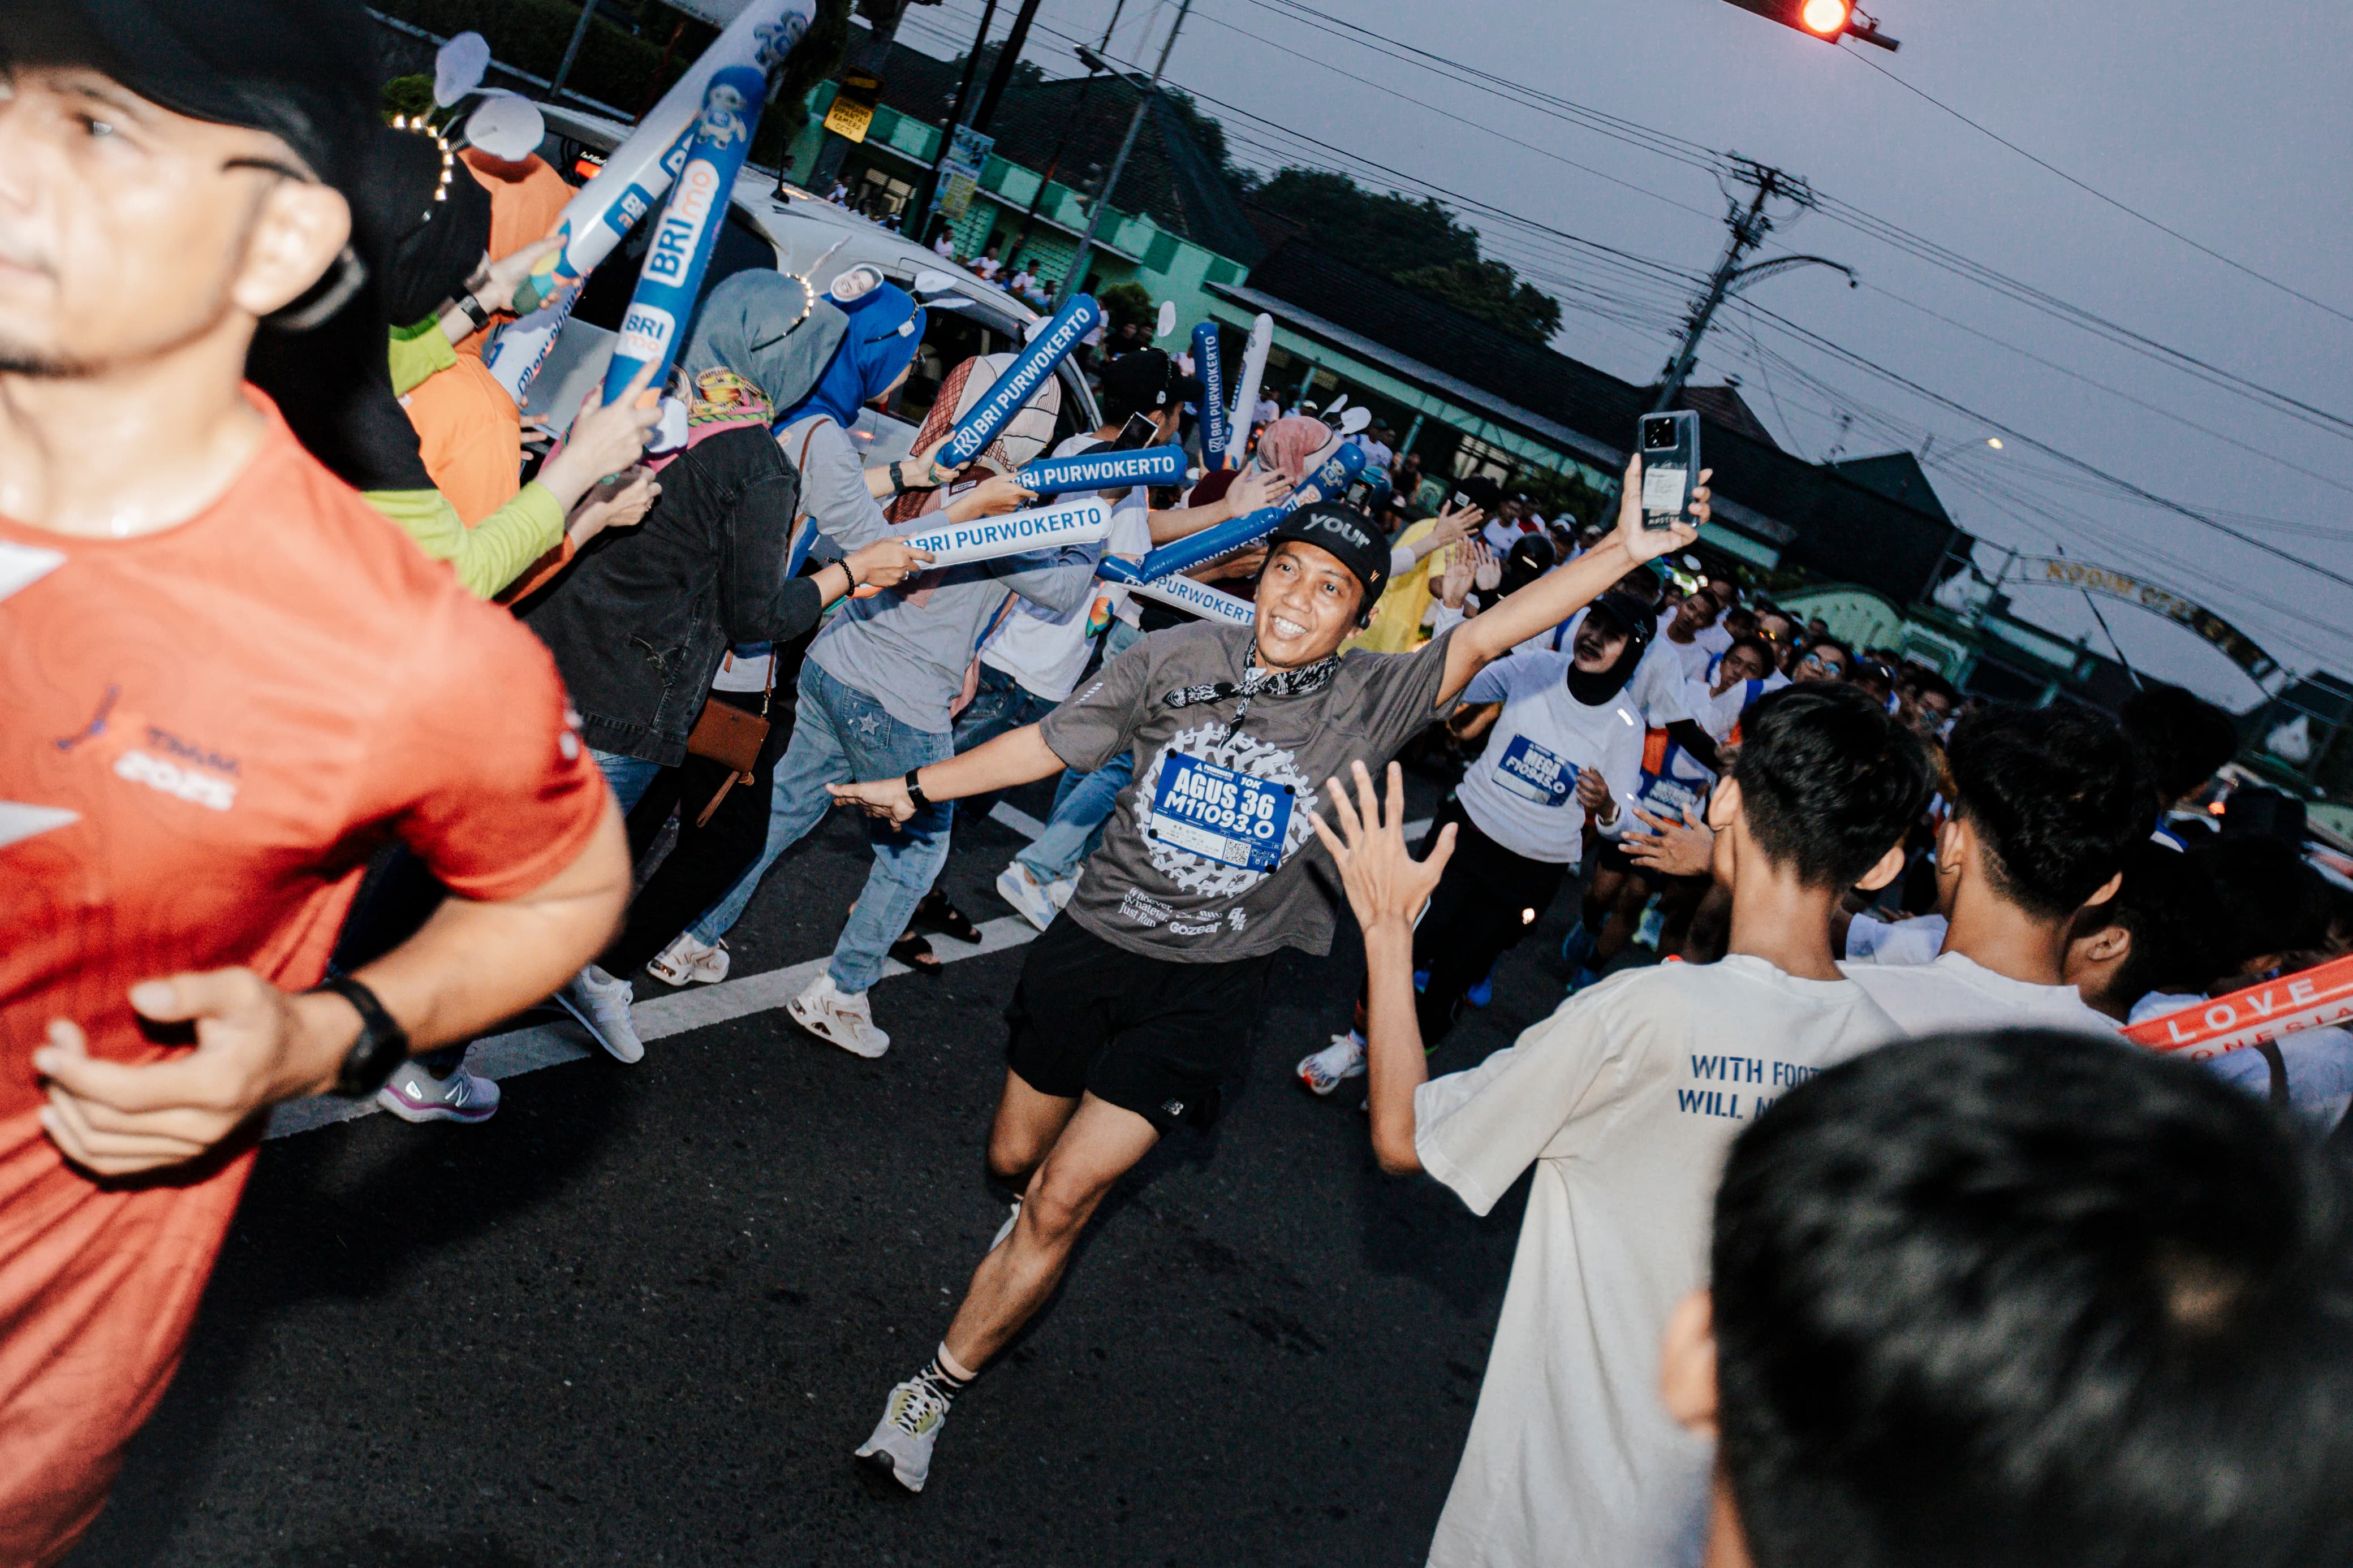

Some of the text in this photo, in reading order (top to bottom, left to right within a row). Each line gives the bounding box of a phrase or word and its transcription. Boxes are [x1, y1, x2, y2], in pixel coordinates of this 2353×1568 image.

[626, 314, 665, 340] BRI
[973, 307, 1091, 435] BRI PURWOKERTO
[1204, 335, 1222, 438] BRI PURWOKERTO
[1044, 456, 1175, 485] PURWOKERTO
[955, 507, 1101, 548] PURWOKERTO
[1156, 577, 1255, 624] PURWOKERT
[1523, 748, 1561, 780] MEGA
[1173, 767, 1276, 820] AGUS 36
[1240, 777, 1263, 790] 10K
[1118, 901, 1157, 928] Just Run
[1129, 887, 1173, 913] Whoever,
[2167, 978, 2320, 1043] LOVE
[1692, 1055, 1762, 1084] WITH
[1678, 1089, 1743, 1119] WILL
